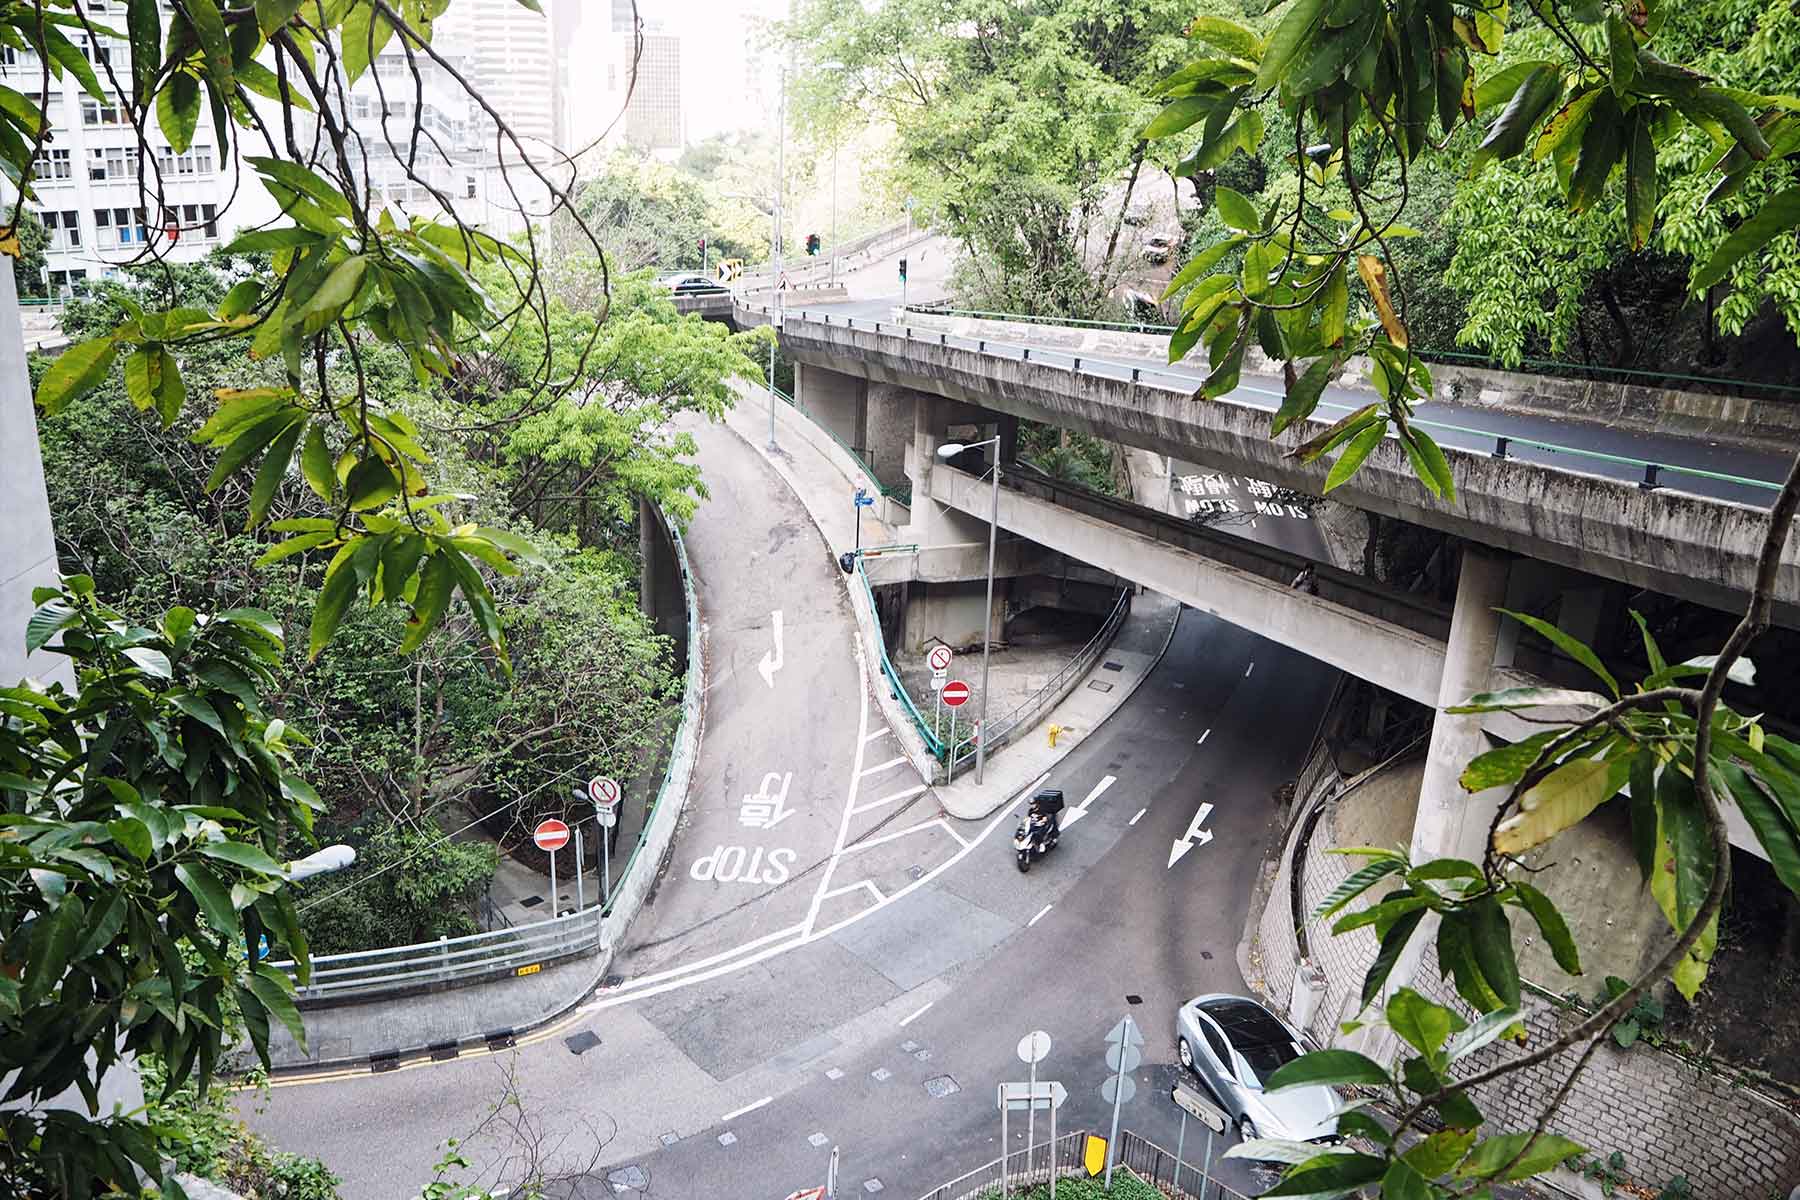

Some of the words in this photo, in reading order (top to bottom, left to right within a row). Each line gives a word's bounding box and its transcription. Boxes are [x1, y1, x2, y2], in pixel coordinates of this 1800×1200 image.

[1184, 498, 1240, 515] SLOW
[1254, 500, 1309, 520] SLOW
[738, 771, 797, 830] 停
[690, 845, 797, 885] STOP
